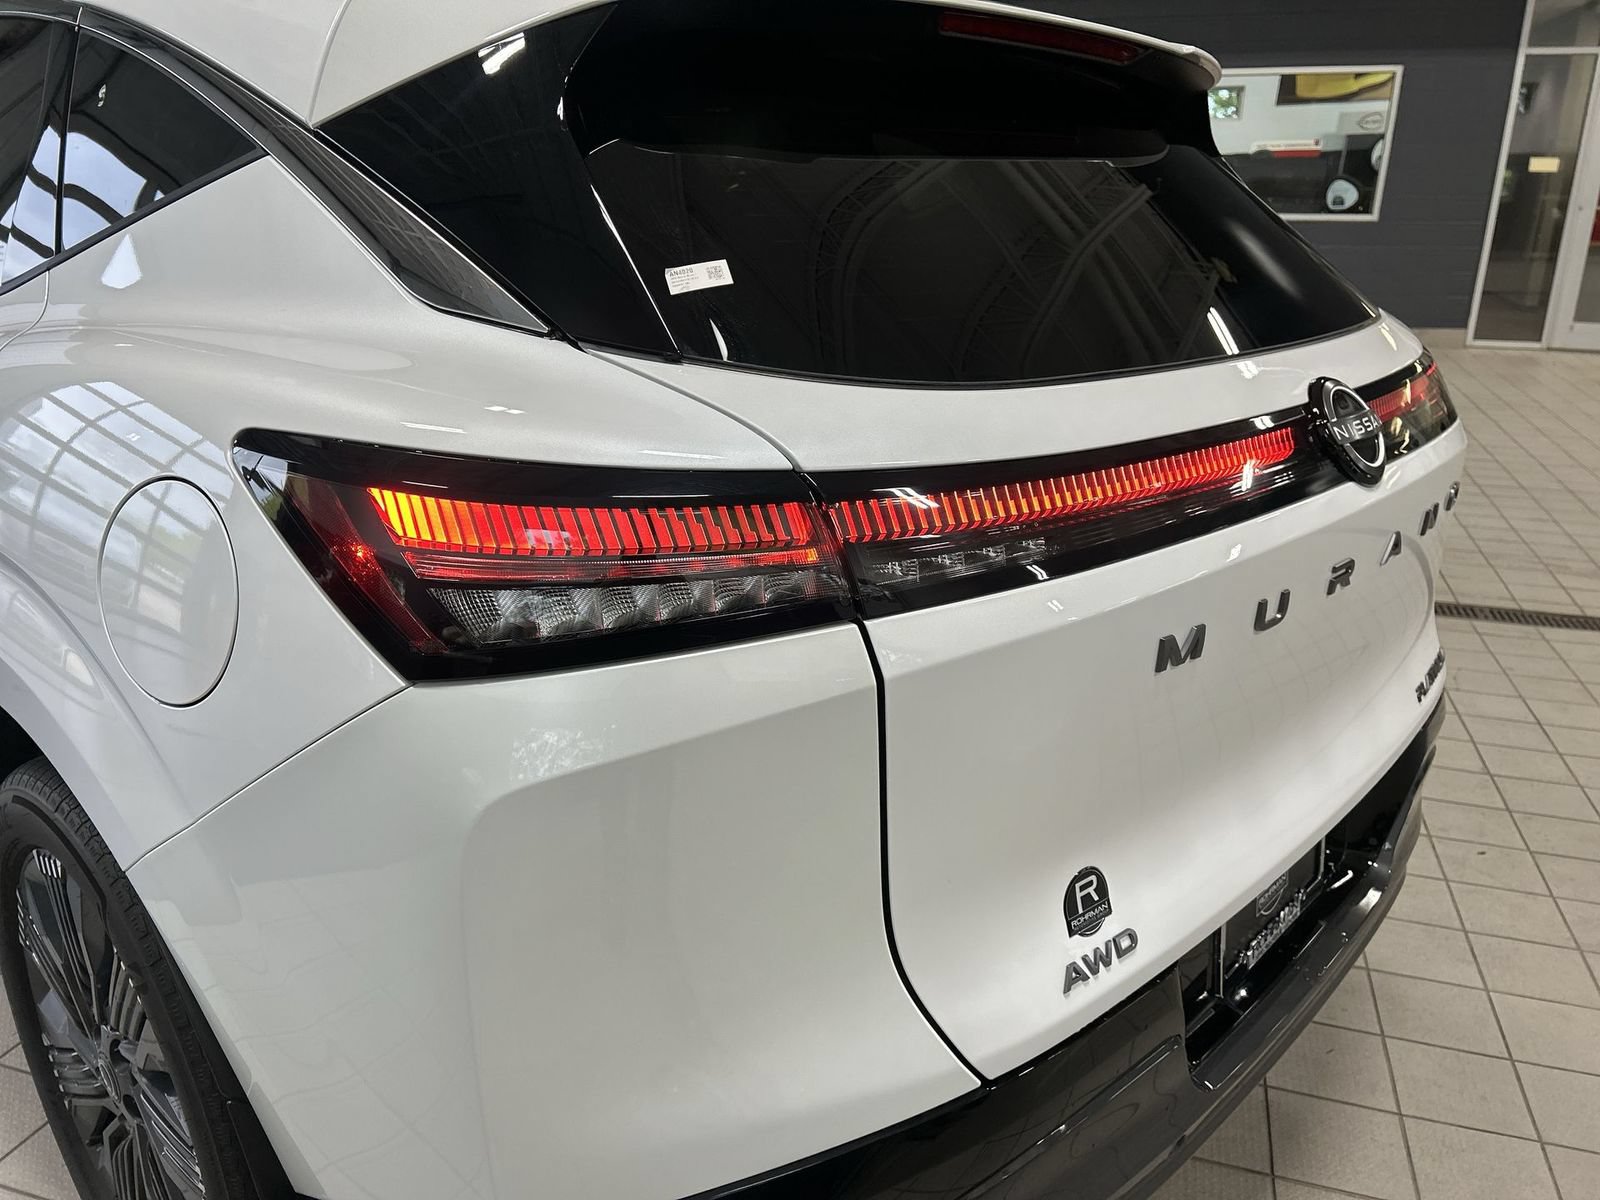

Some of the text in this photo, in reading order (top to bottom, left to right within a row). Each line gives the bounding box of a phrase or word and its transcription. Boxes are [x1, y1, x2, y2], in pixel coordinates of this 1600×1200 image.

[1075, 874, 1099, 914] R
[1071, 901, 1109, 929] ROHRMAN
[1062, 927, 1139, 995] AWD
